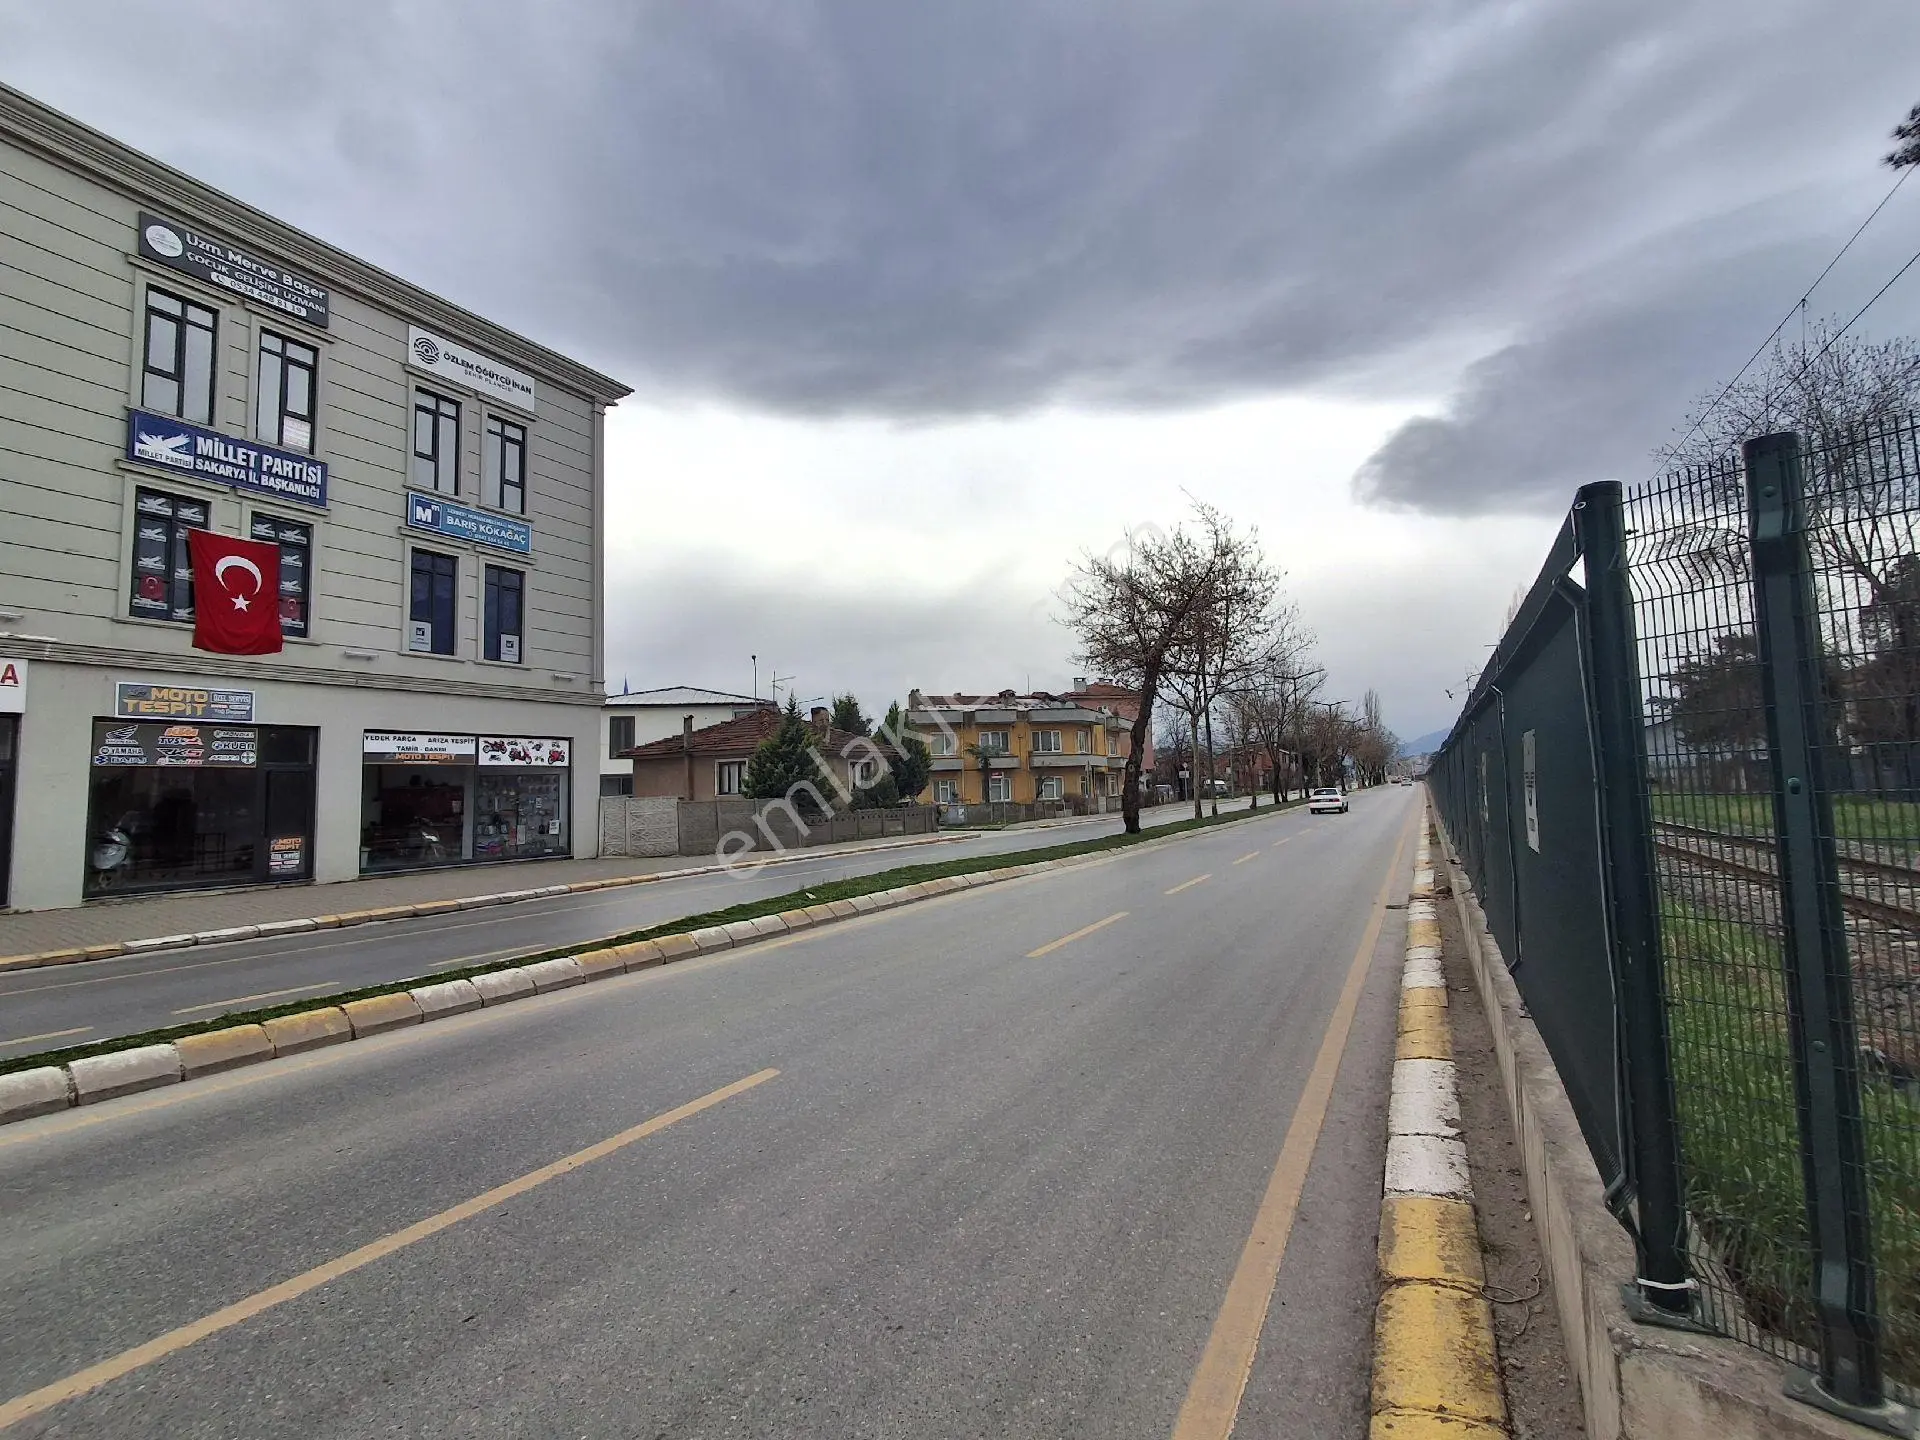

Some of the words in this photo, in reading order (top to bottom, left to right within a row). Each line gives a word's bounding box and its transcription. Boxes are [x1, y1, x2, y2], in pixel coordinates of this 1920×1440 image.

[185, 232, 224, 258] Uzm.
[227, 250, 277, 279] Merve
[282, 273, 326, 300] Başer
[186, 252, 230, 275] ÇOCUK
[234, 271, 279, 295] GELİŞİM
[283, 291, 326, 315] UZMANI
[444, 350, 474, 371] ÖZLEM
[138, 448, 163, 461] MİLLET
[197, 436, 258, 468] MİLLET
[261, 453, 322, 486] PARTİSİ
[195, 458, 247, 481] SAKARYA
[248, 470, 259, 485] İL
[261, 474, 320, 499] BAŞKANLIĞI
[446, 516, 477, 532] BARIŞ
[480, 523, 526, 544] KÖKAĞAÇ
[151, 687, 208, 703] MOTO
[123, 698, 206, 716] TESPİT
[111, 747, 144, 755] YAMAHA
[223, 742, 256, 750] KUBA
